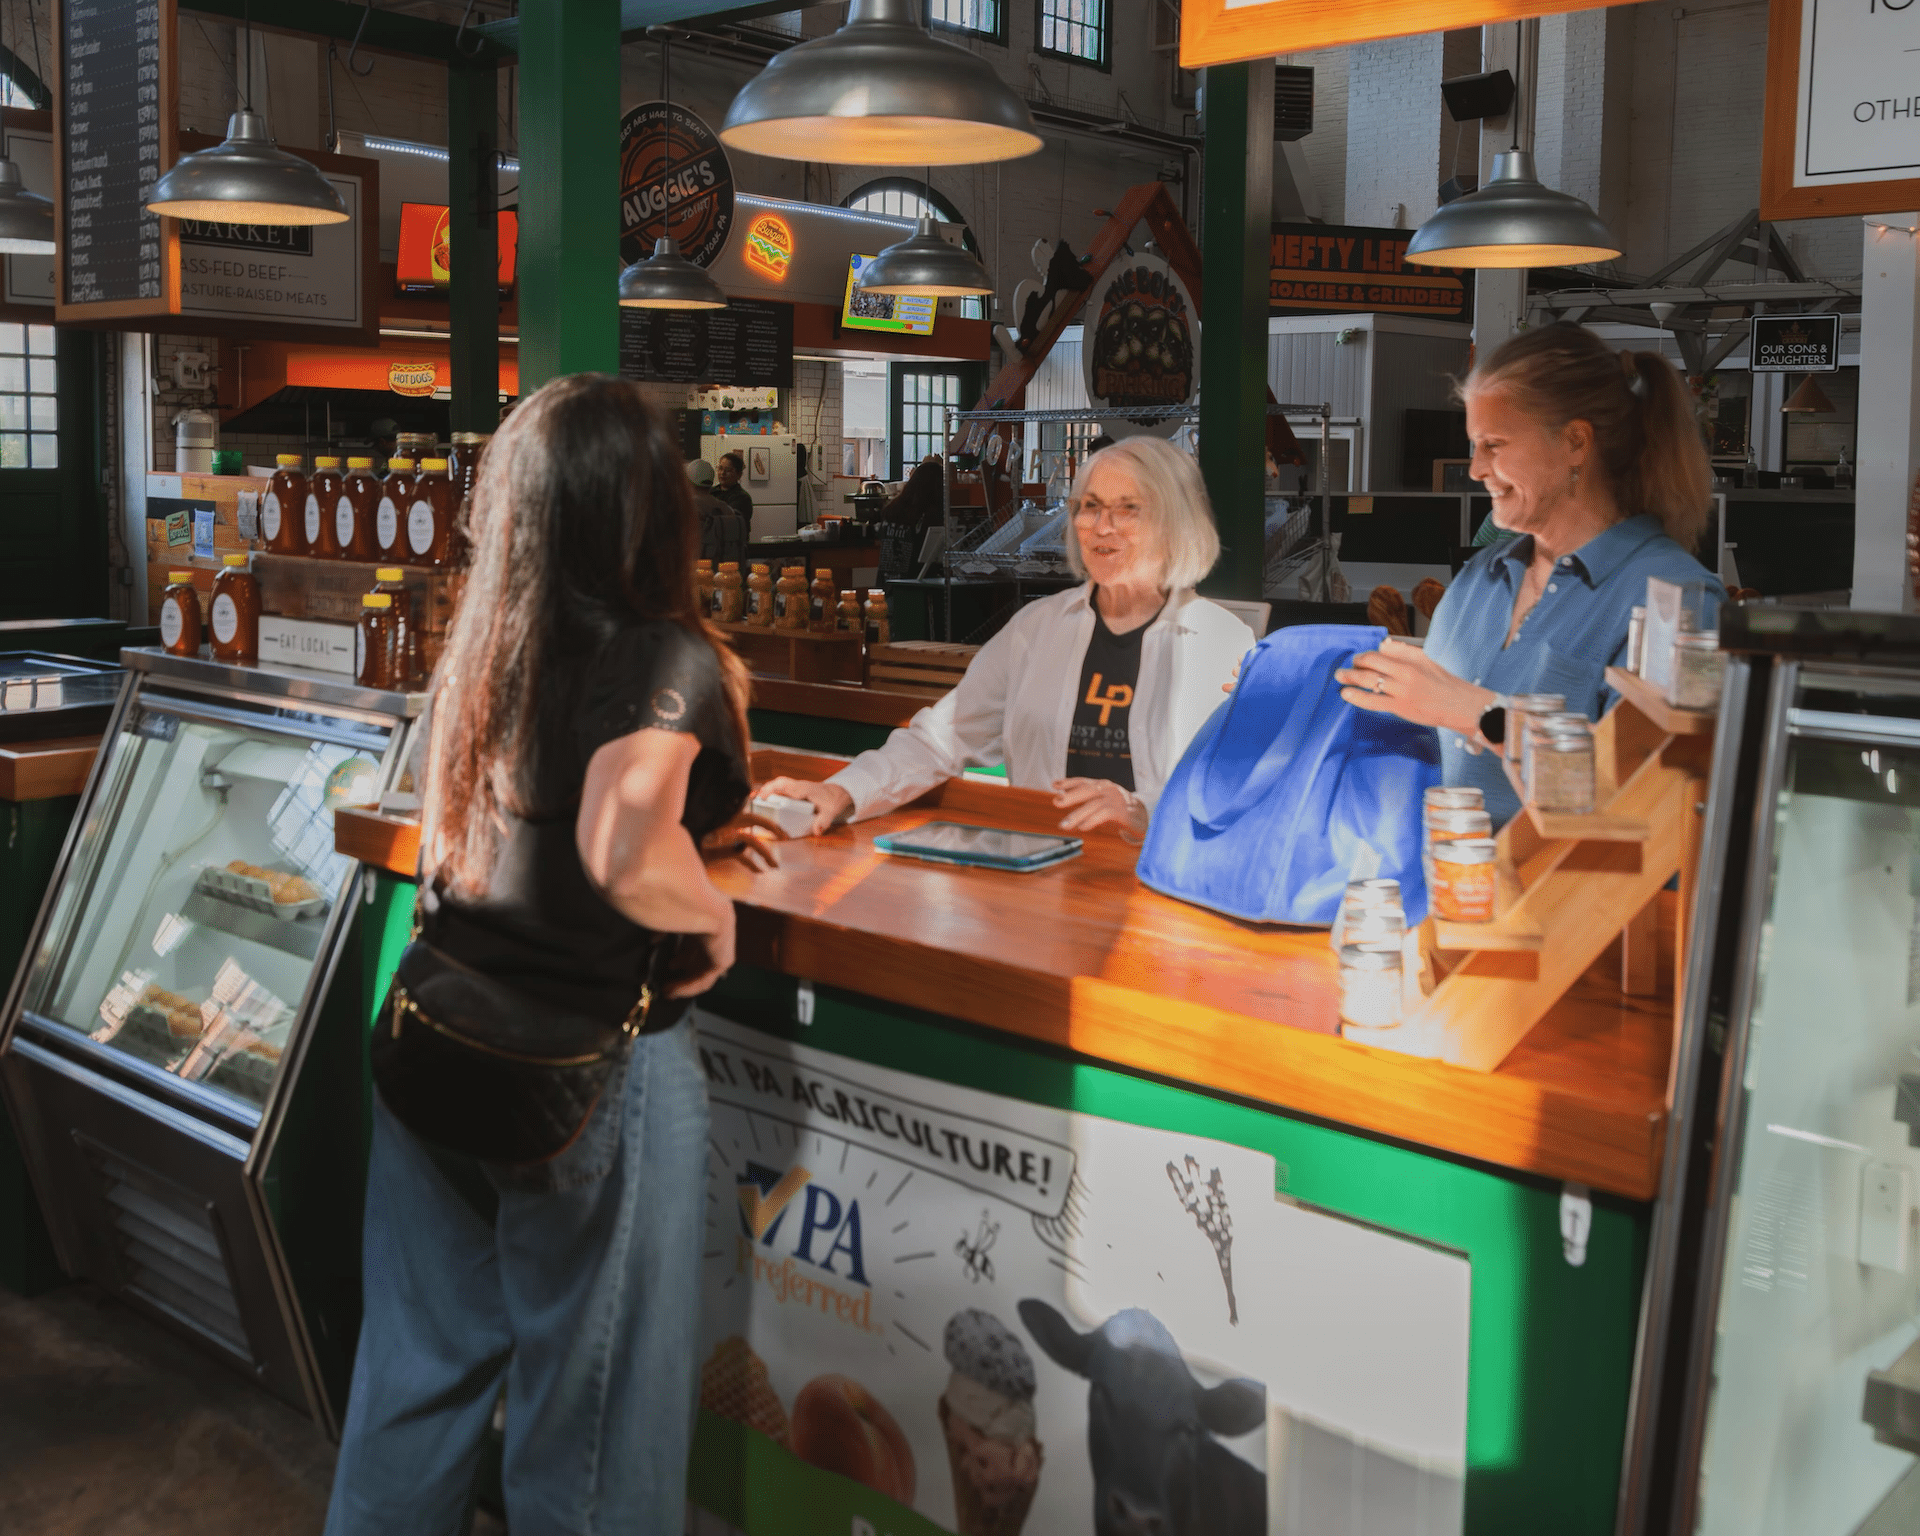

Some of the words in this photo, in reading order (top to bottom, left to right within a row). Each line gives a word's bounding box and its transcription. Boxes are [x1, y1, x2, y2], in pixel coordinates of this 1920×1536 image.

[633, 113, 647, 127] ARE
[672, 112, 683, 122] TO
[685, 118, 708, 139] BEAT!
[623, 160, 715, 227] AUGGIE'S
[180, 219, 299, 246] MARKET
[704, 231, 721, 255] YORK
[717, 214, 727, 230] PA
[757, 221, 788, 245] Burgers
[1270, 234, 1356, 270] HEFTY
[248, 263, 287, 281] BEEF
[286, 292, 328, 306] MEATS
[1352, 286, 1365, 301] &
[1368, 287, 1463, 305] GRINDERS
[1760, 344, 1785, 354] OUR
[1788, 344, 1817, 354] SONS
[1819, 344, 1828, 353] &
[1761, 354, 1826, 365] DAUGHTERS
[393, 372, 408, 384] HOT
[411, 371, 432, 384] DOGS
[280, 633, 296, 650] EAT
[301, 637, 330, 655] LOCAL
[741, 1059, 784, 1098] PA
[791, 1073, 1053, 1197] AGRICULTURE!
[791, 1184, 872, 1288] PA
[735, 1234, 873, 1332] Preferred
